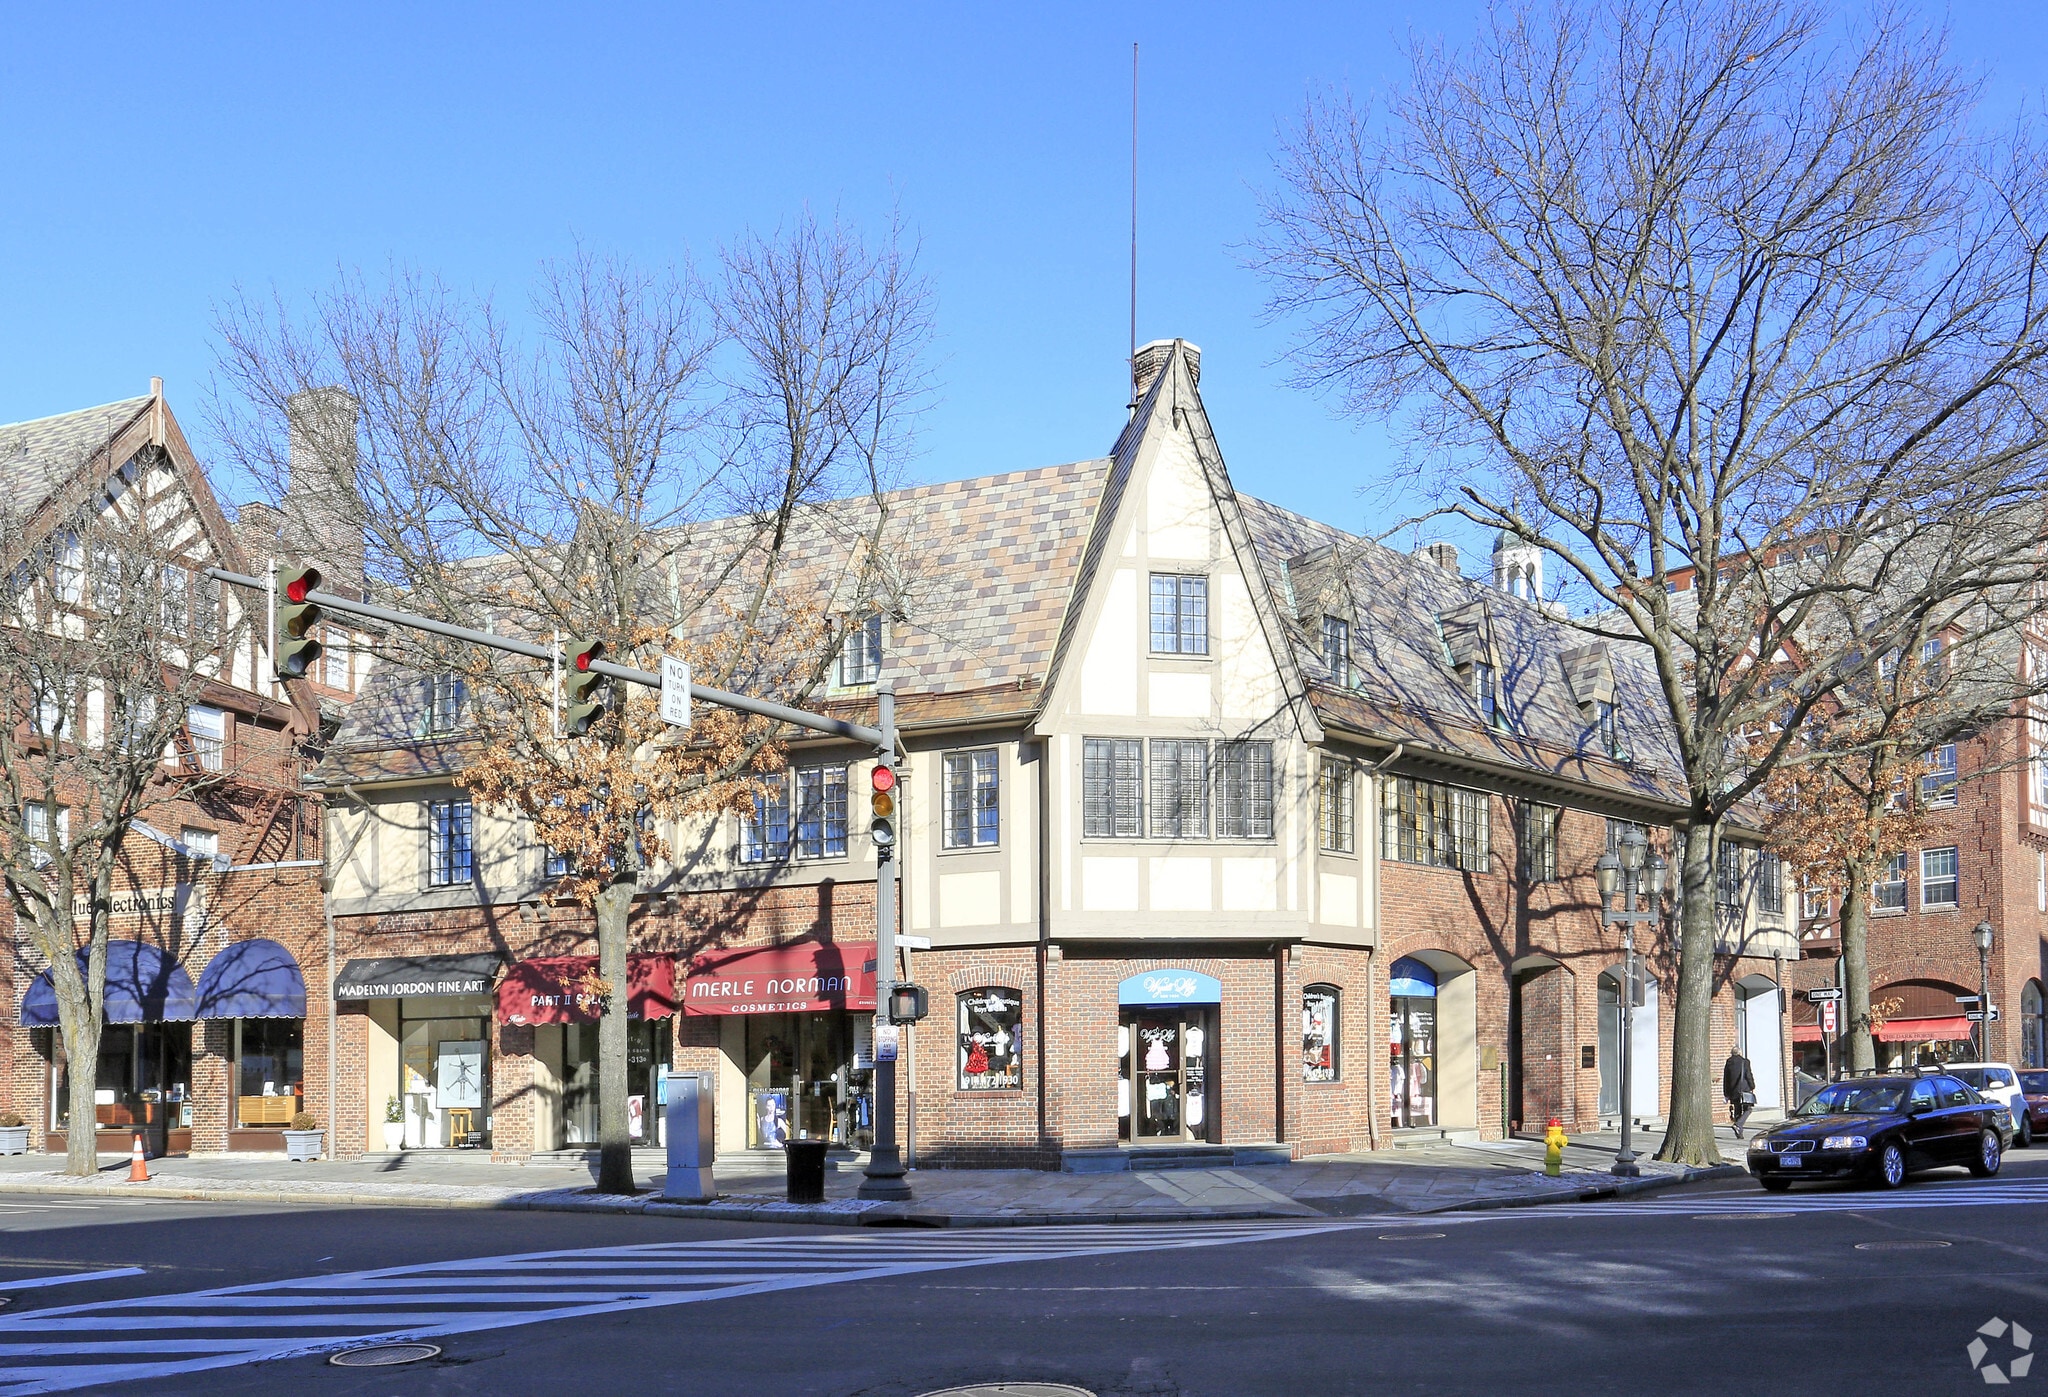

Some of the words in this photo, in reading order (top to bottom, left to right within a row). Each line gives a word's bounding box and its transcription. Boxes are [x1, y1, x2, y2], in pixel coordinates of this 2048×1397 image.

[669, 664, 683, 679] NO
[668, 680, 685, 693] TURN
[671, 694, 682, 705] ON
[670, 707, 683, 719] RED
[108, 893, 175, 914] lectronics
[338, 984, 389, 997] MADELYN
[390, 982, 435, 995] JORDON
[437, 981, 462, 993] FINE
[463, 980, 486, 992] ART
[692, 980, 754, 997] MERLE
[767, 976, 852, 994] NORMAN
[531, 995, 560, 1006] PART
[731, 1001, 807, 1012] COSMETICS
